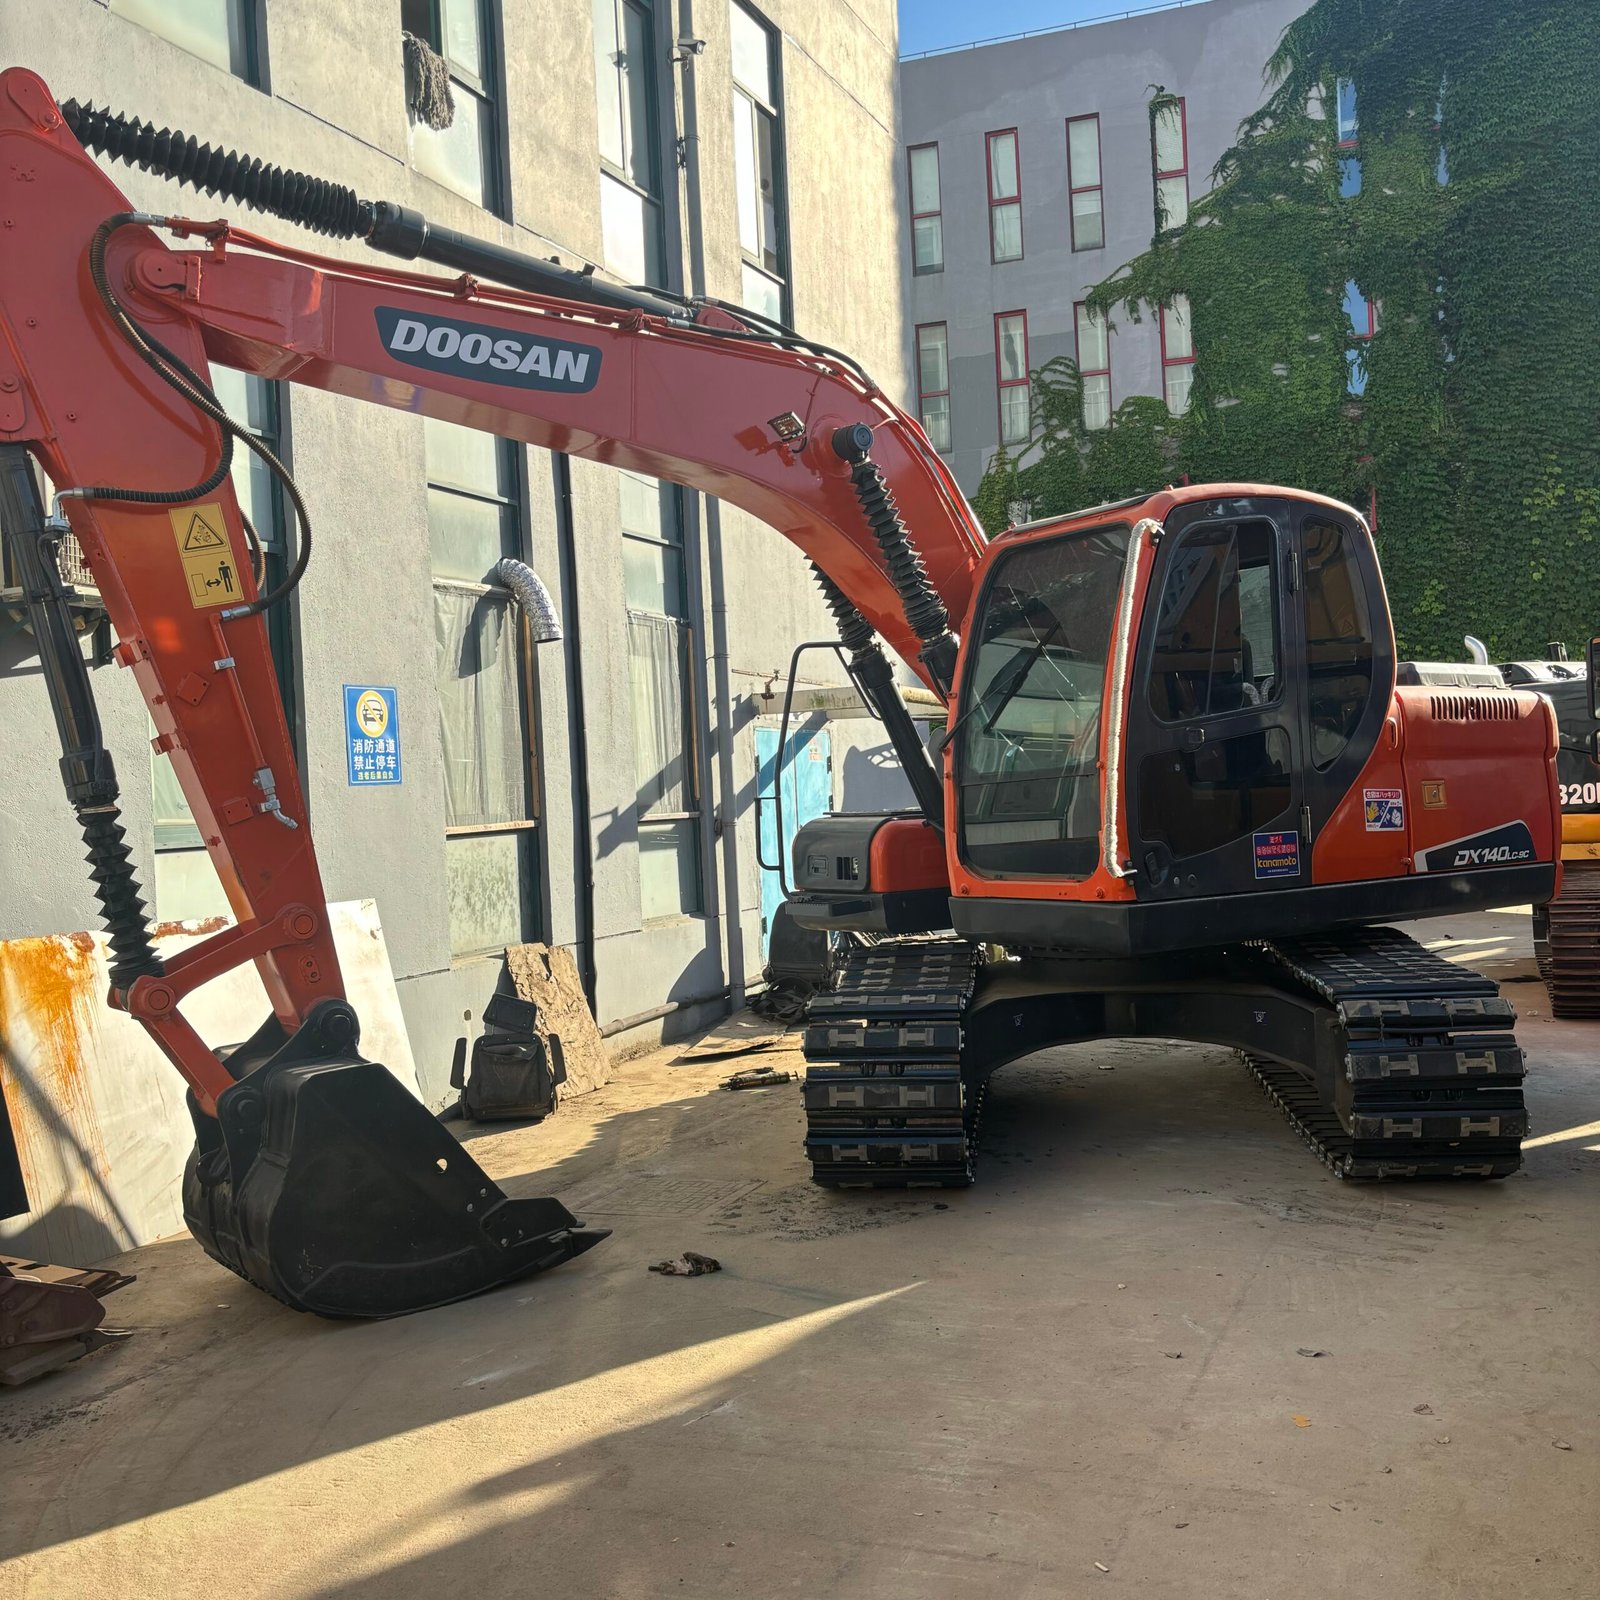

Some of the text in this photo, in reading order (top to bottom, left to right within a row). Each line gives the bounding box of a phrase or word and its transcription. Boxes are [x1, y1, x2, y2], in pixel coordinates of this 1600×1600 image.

[390, 319, 590, 383] DOOSAN
[353, 738, 396, 754] 消防通道
[354, 755, 397, 770] 禁止停车
[1559, 782, 1600, 805] 320
[1257, 856, 1297, 868] kanamoto
